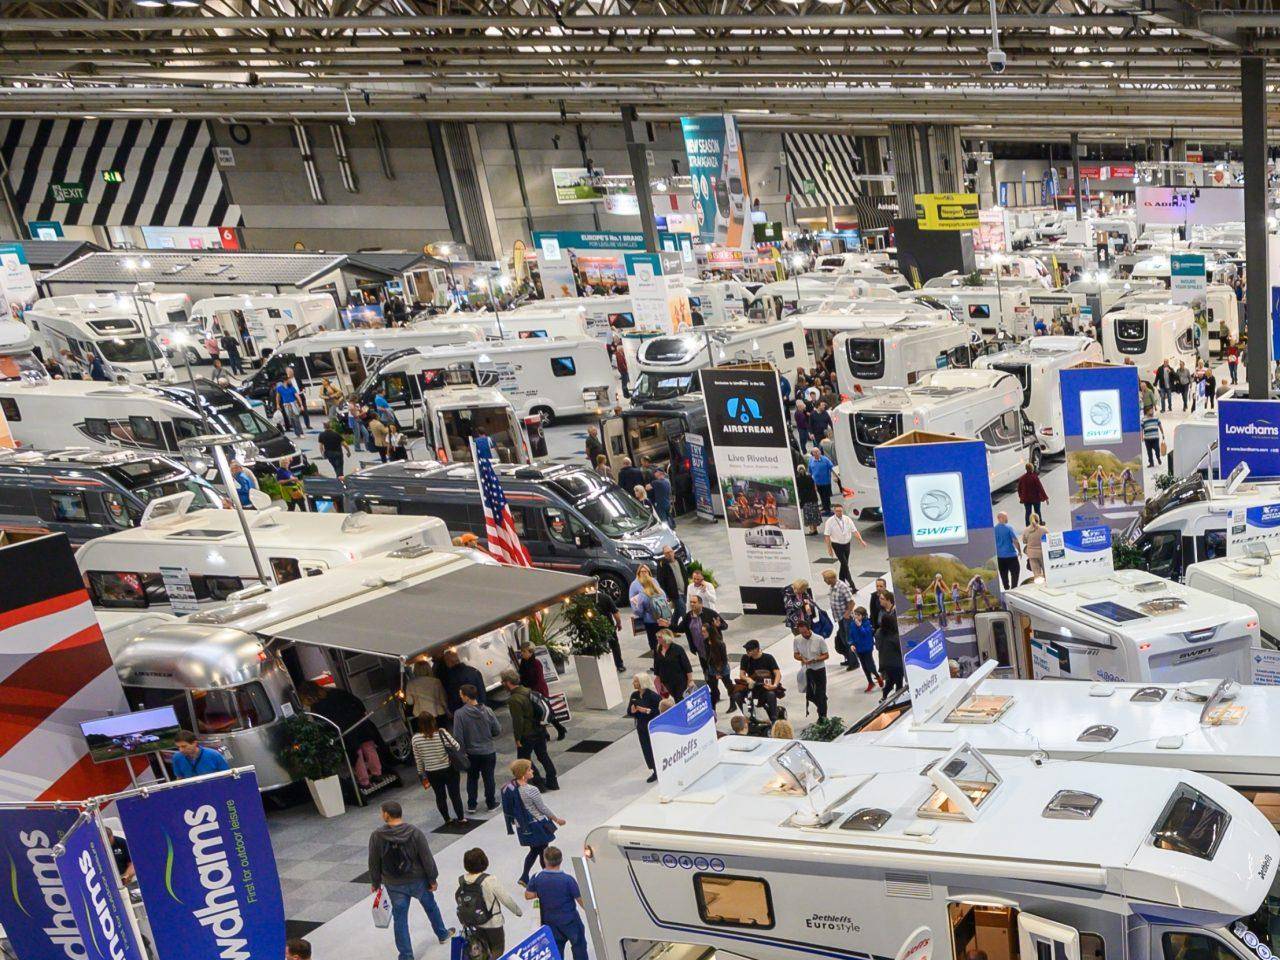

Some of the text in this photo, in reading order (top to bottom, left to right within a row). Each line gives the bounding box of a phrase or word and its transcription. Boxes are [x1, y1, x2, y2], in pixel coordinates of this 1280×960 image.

[63, 188, 84, 199] EXIT
[223, 230, 233, 240] 6
[722, 424, 774, 434] AIRSTREAM
[1225, 423, 1279, 435] Lowdhams
[728, 454, 779, 464] Live Riveted
[916, 525, 963, 536] SWIFT
[226, 799, 242, 830] leisure
[233, 829, 248, 867] outdoor
[246, 880, 258, 904] First
[812, 913, 851, 924] Dethleffs
[806, 918, 861, 933] Eurostyle
